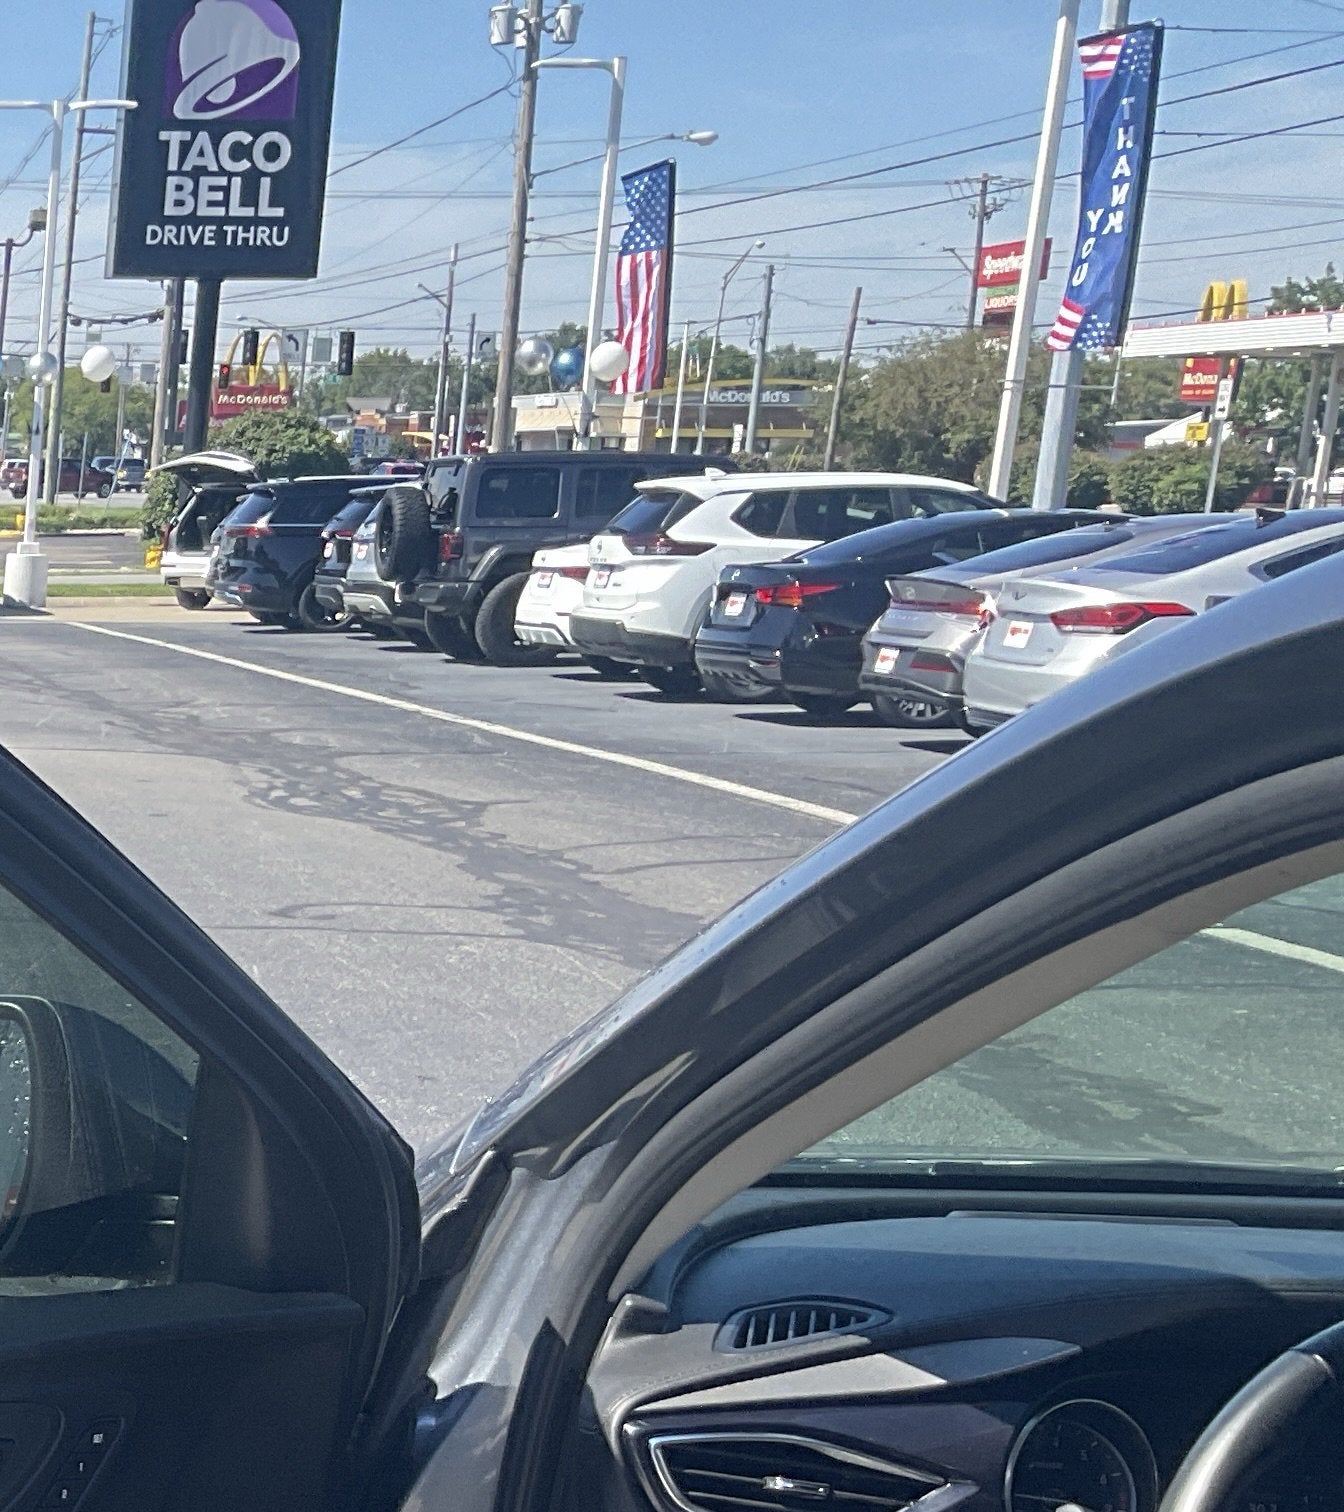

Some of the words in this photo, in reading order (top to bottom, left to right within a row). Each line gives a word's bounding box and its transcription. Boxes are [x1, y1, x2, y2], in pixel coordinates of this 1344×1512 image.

[158, 130, 292, 173] TACO
[1101, 95, 1136, 236] THANK
[163, 175, 285, 218] BELL
[145, 224, 217, 246] DRIVE
[223, 225, 290, 247] THRU
[1071, 207, 1105, 287] YOU
[982, 250, 1025, 280] Speedw
[217, 393, 289, 406] McDonald's
[708, 388, 791, 404] McDold's
